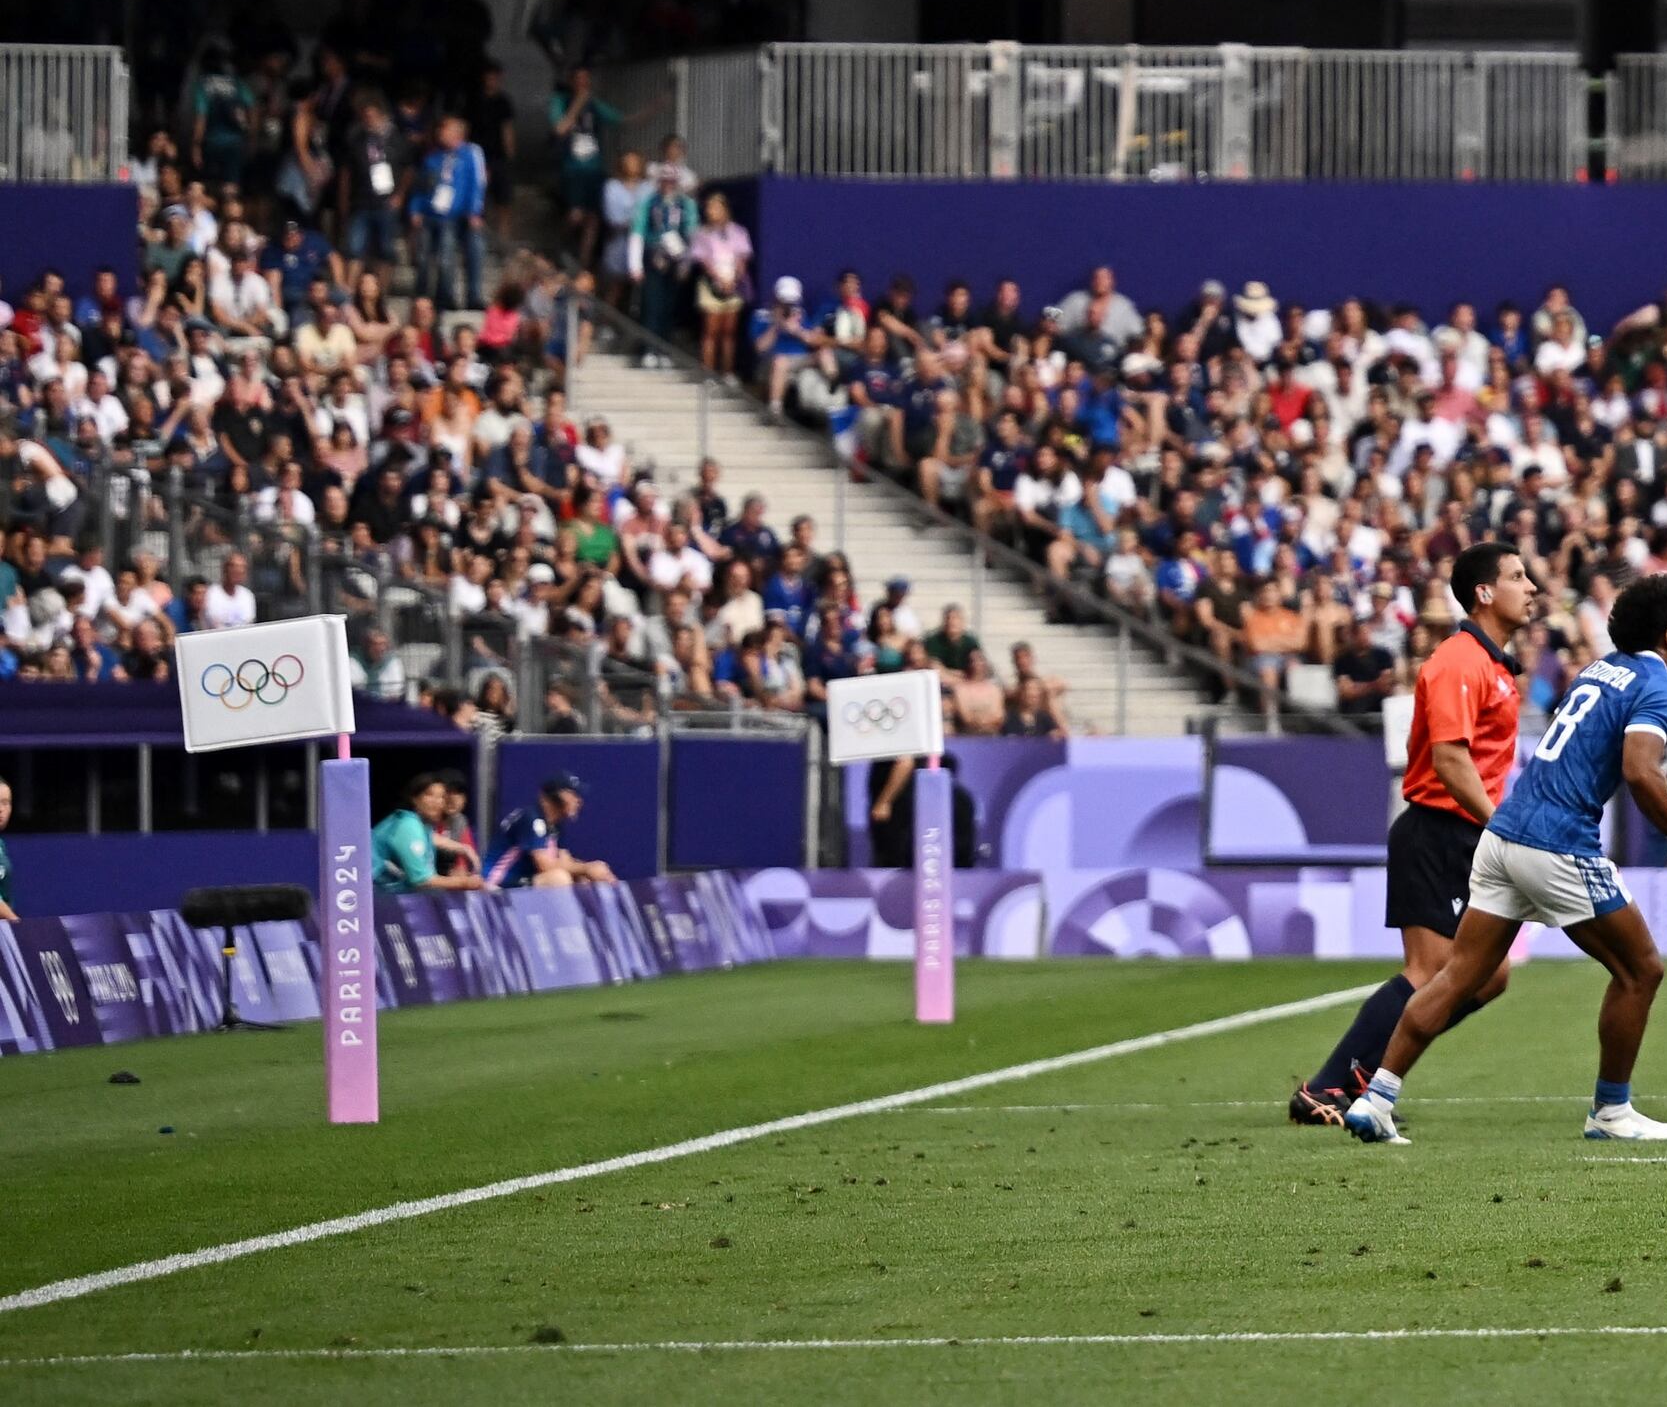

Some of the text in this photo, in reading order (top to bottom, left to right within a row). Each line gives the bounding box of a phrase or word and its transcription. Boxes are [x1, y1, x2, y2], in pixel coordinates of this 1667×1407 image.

[1535, 684, 1602, 762] 8
[335, 845, 362, 1048] PARIS 2024
